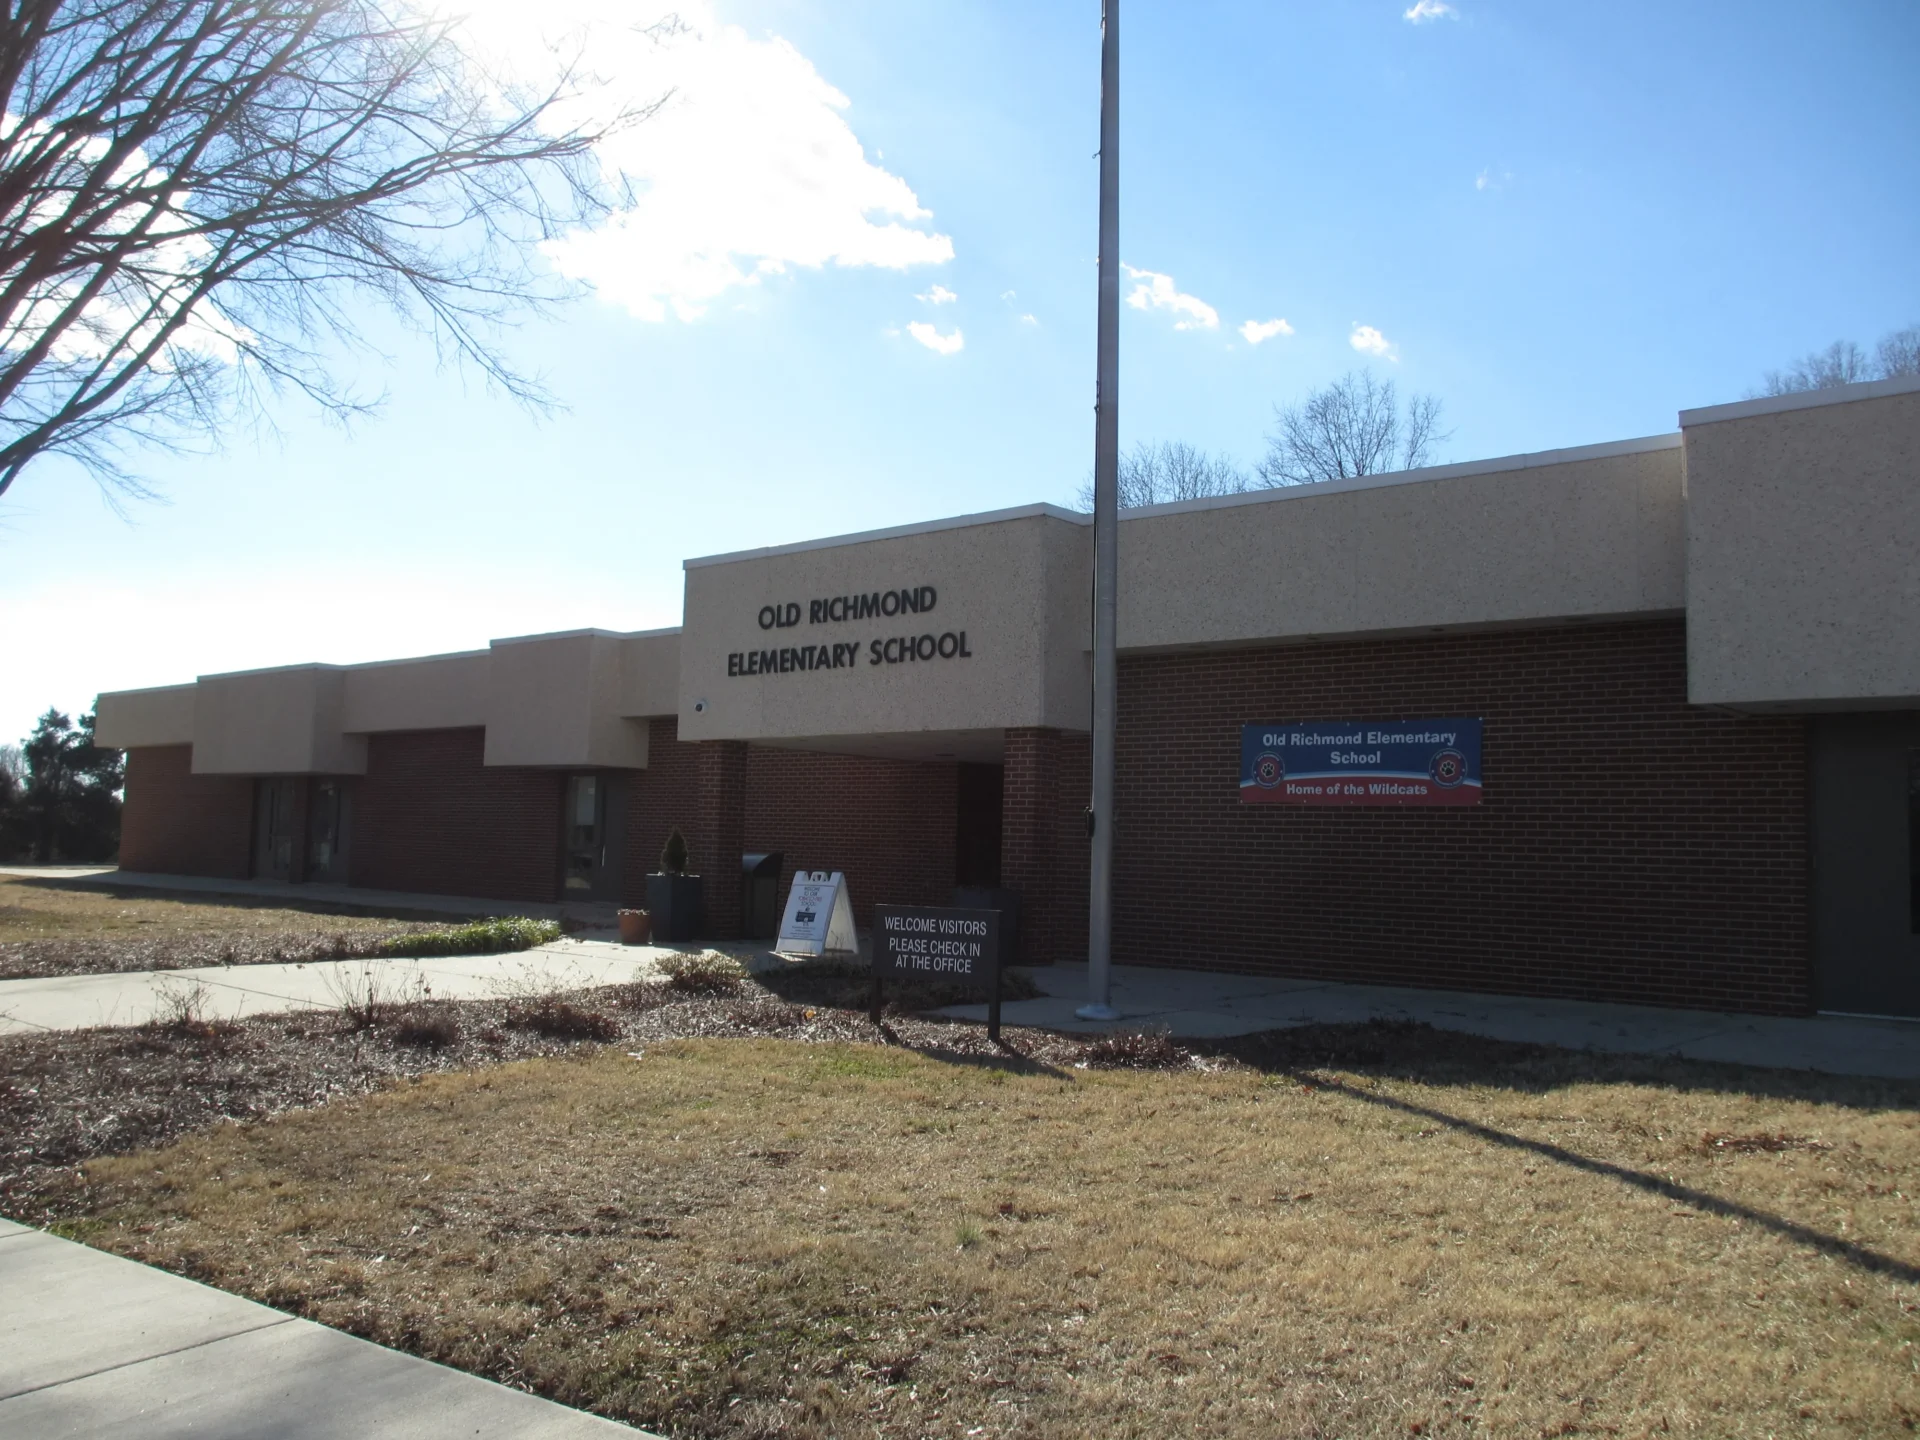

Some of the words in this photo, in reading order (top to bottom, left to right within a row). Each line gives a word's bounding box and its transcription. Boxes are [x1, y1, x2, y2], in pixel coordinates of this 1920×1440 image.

[758, 603, 801, 630] OLD
[809, 586, 937, 624] RICHMOND
[727, 642, 861, 677] ELEMENTARY
[869, 631, 972, 665] SCHOOL
[1262, 733, 1286, 747] Old
[1290, 731, 1362, 746] Richmond
[1367, 731, 1457, 746] Elementary
[1330, 751, 1381, 764] School
[1286, 784, 1322, 795] Home
[1327, 783, 1341, 795] of
[1344, 783, 1365, 795] the
[1369, 783, 1428, 795] Wildcats
[885, 916, 936, 932] WELCOME
[939, 920, 987, 935] VISITORS
[889, 937, 927, 953] PLEASE
[930, 940, 967, 956] CHECK
[969, 943, 981, 957] IN
[895, 954, 909, 968] AT
[911, 955, 931, 970] THE
[933, 957, 972, 973] OFFICE
